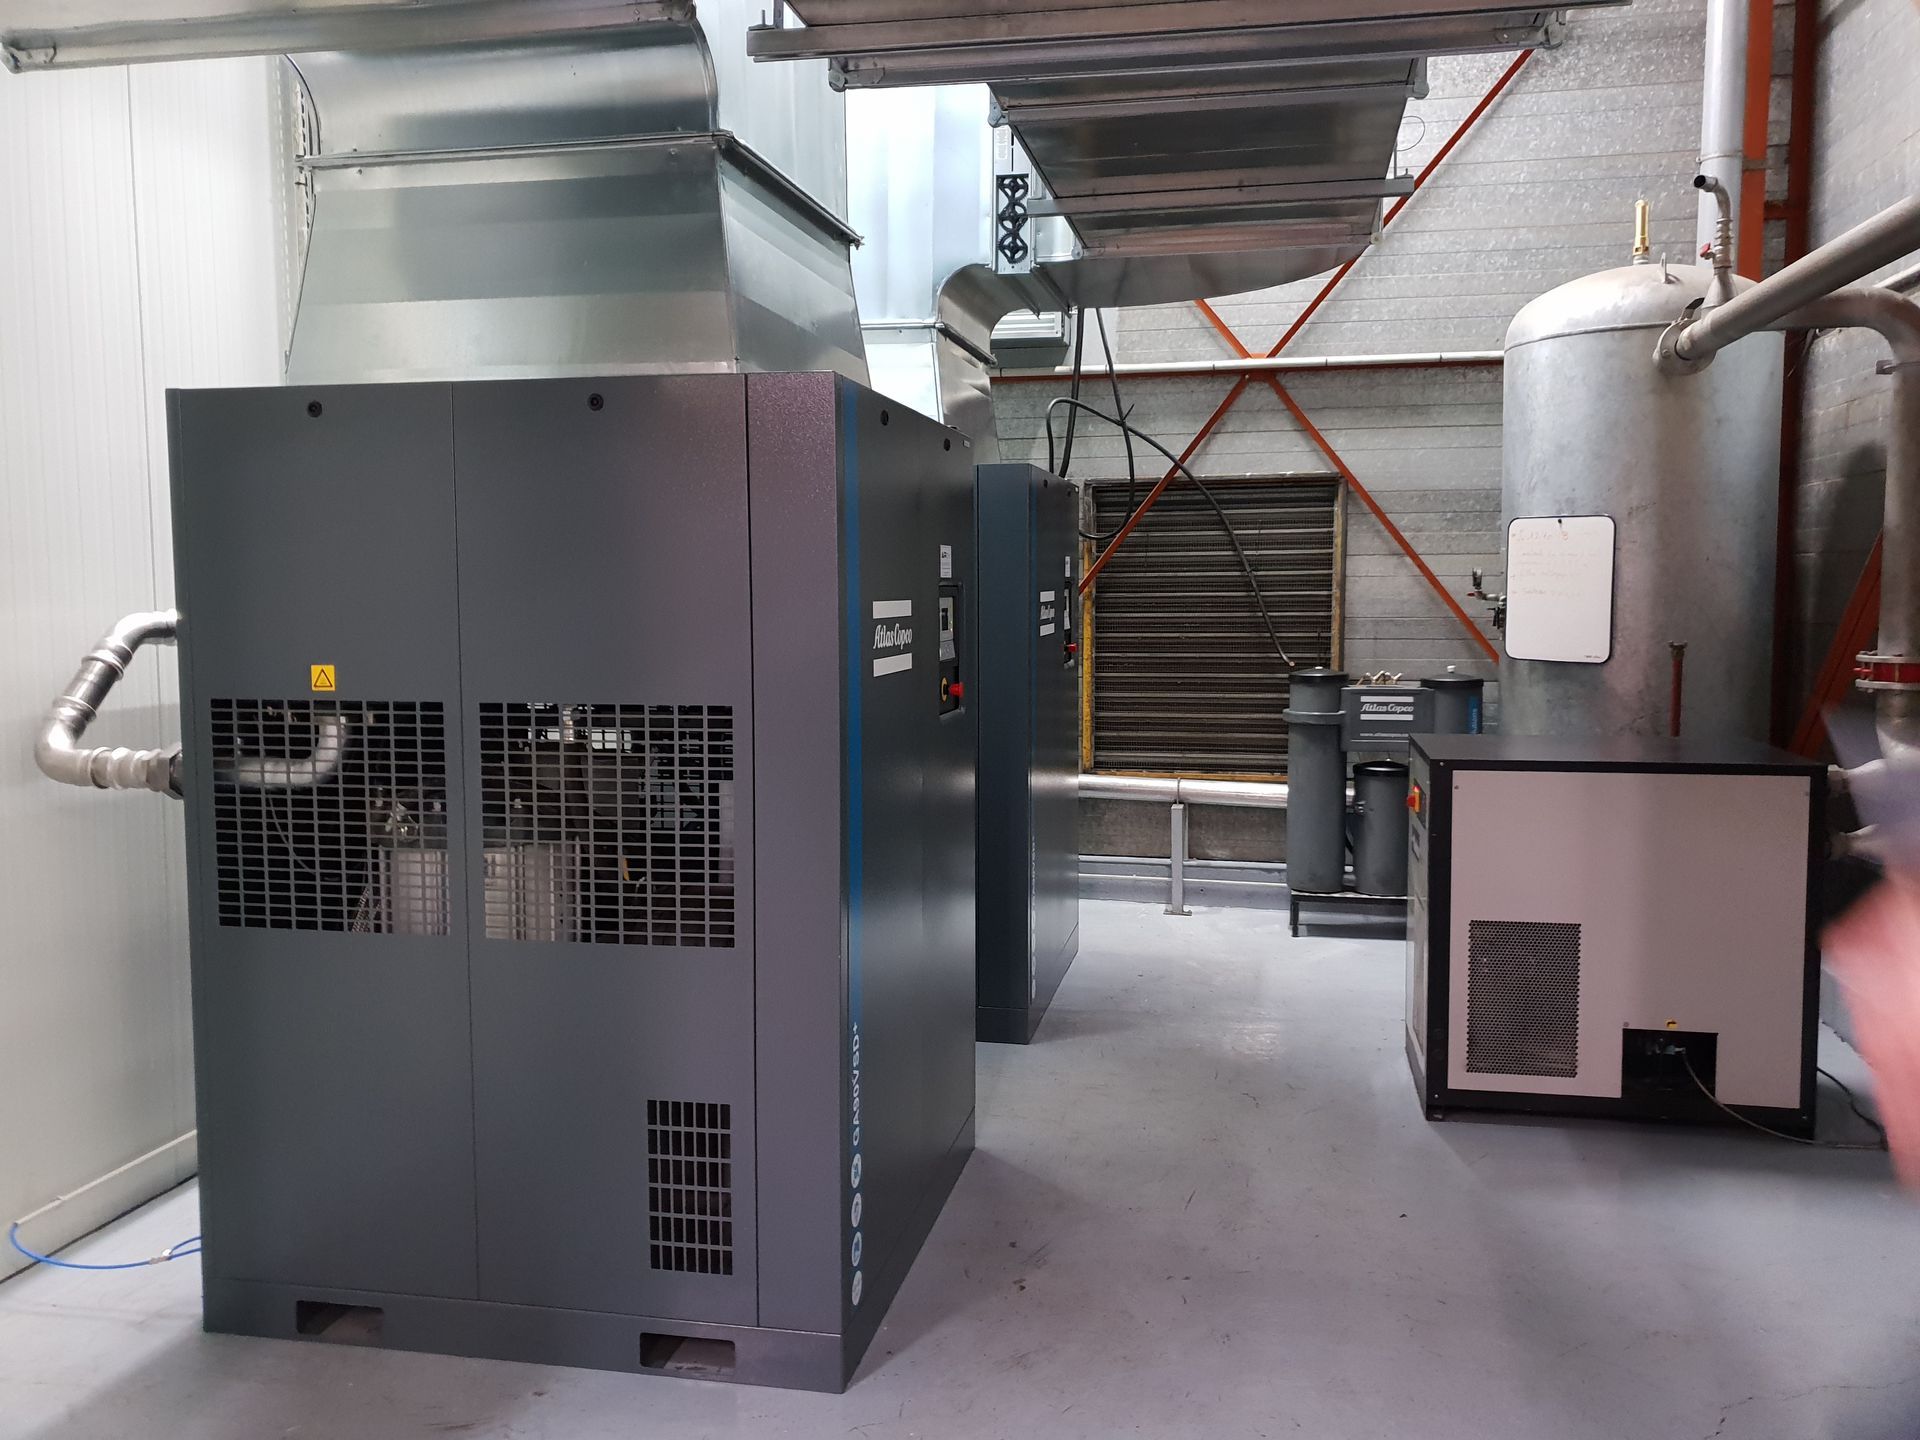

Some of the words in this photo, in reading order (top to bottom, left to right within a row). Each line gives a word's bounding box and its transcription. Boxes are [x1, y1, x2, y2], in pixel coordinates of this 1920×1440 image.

[873, 624, 894, 649] Atlas
[894, 623, 913, 650] Copco
[1360, 703, 1387, 712] Atlas
[1388, 703, 1414, 714] Copco
